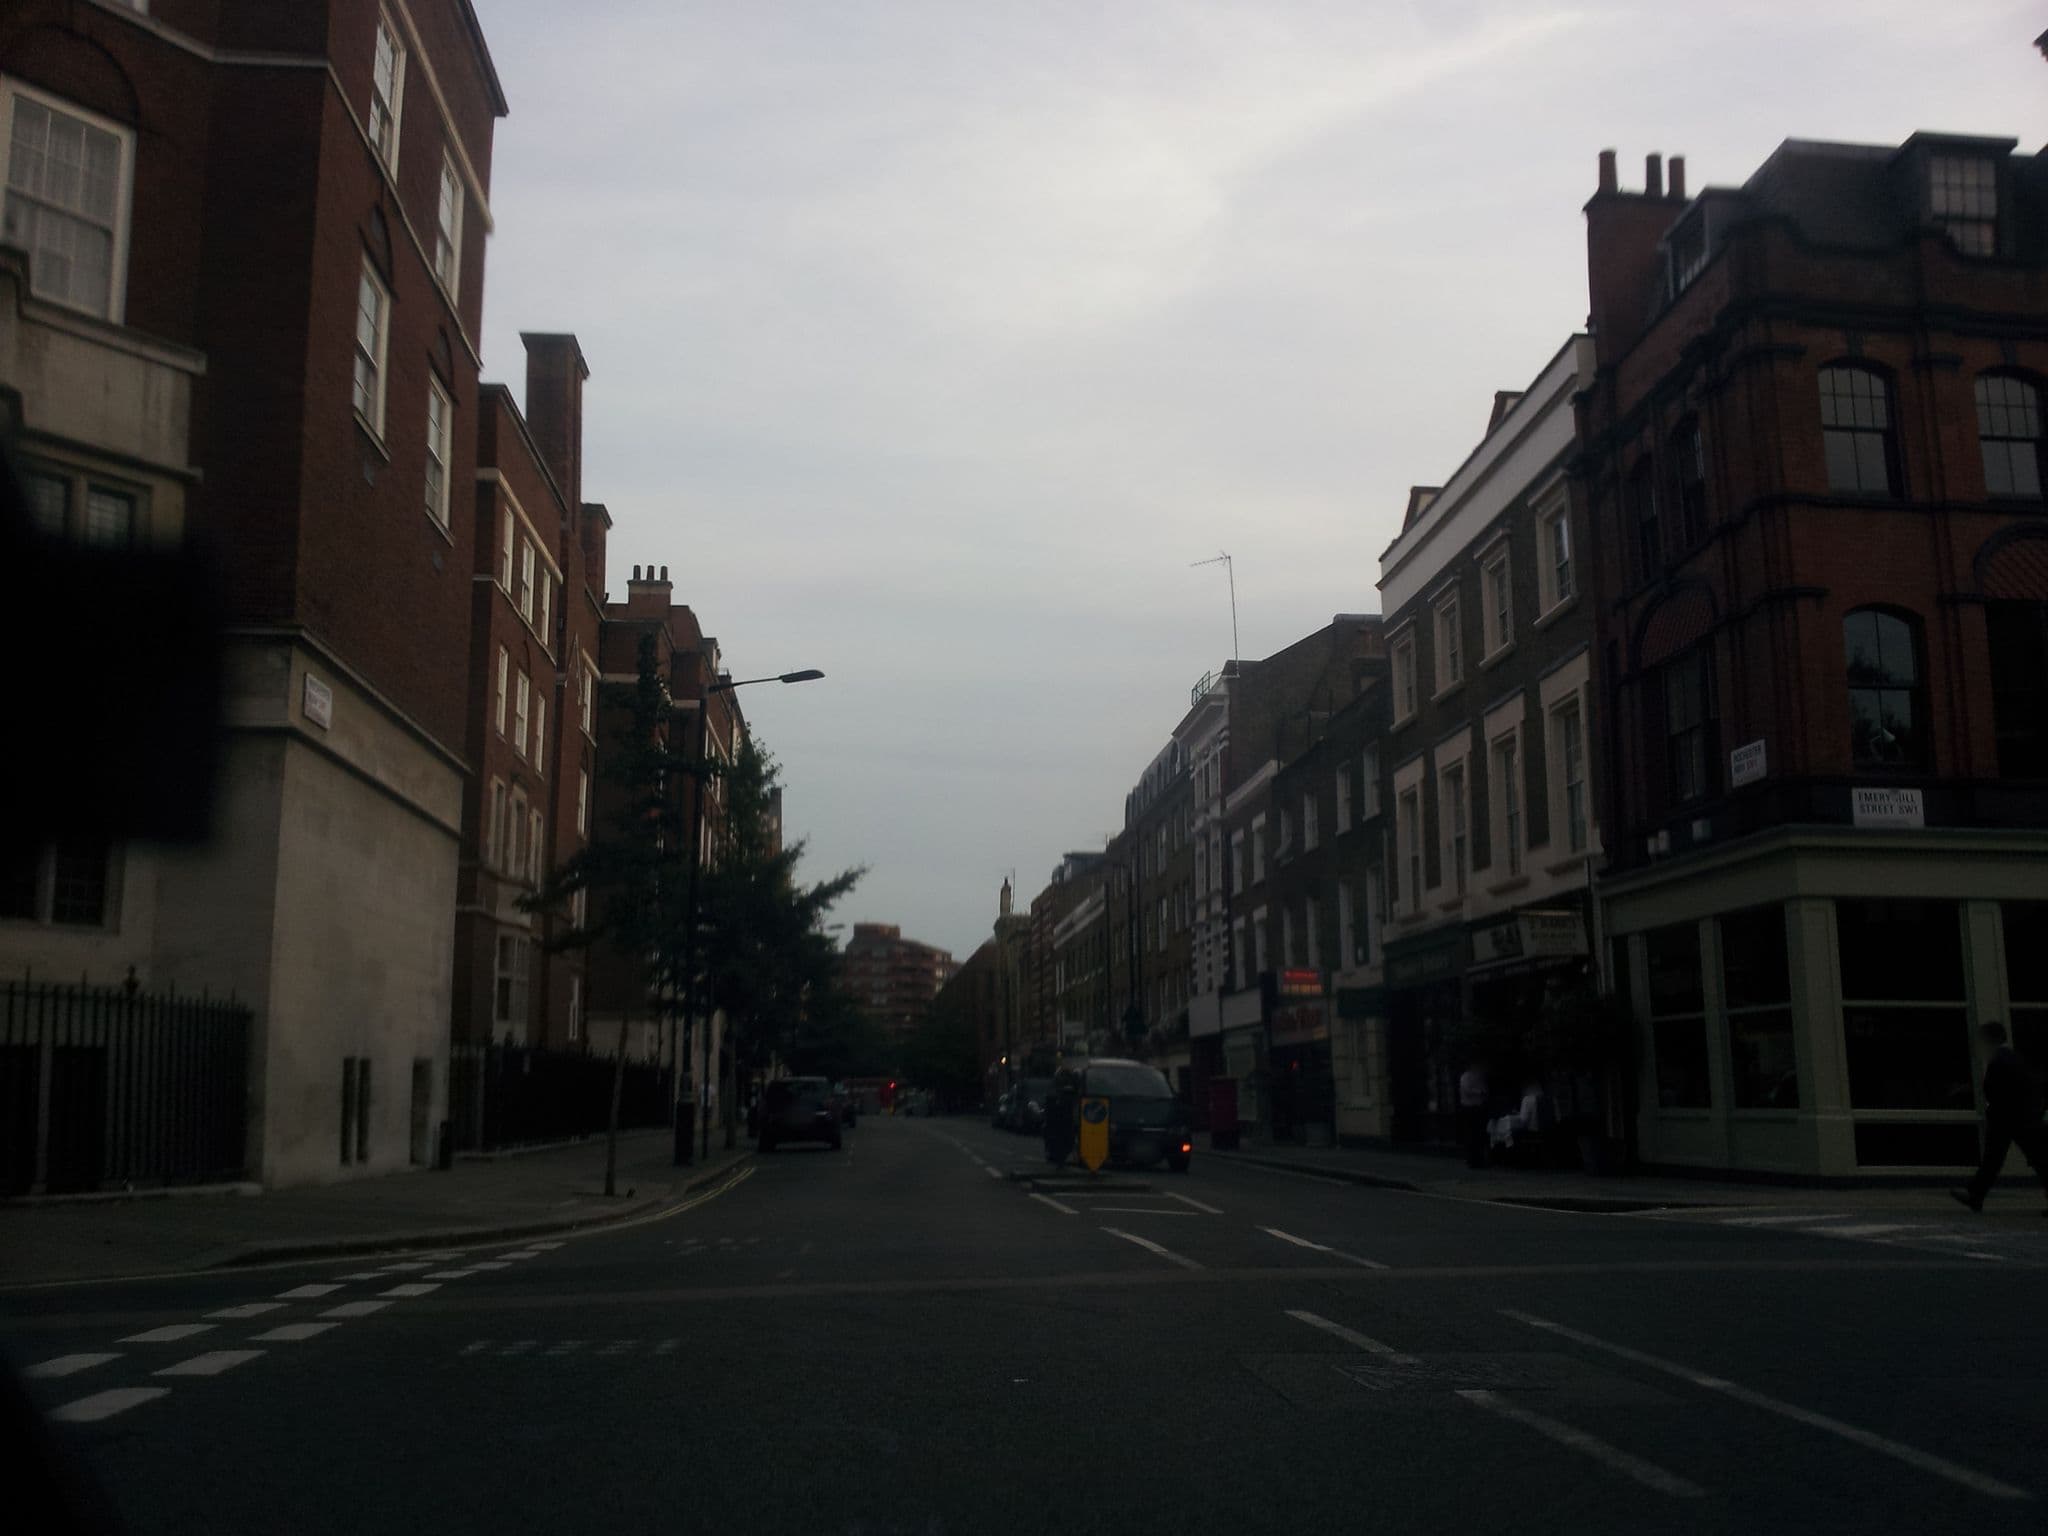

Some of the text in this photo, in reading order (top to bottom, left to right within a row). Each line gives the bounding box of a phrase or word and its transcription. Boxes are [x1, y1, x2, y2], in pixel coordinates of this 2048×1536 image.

[1857, 791, 1889, 802] EMERY
[1859, 804, 1919, 815] STREET SW1
